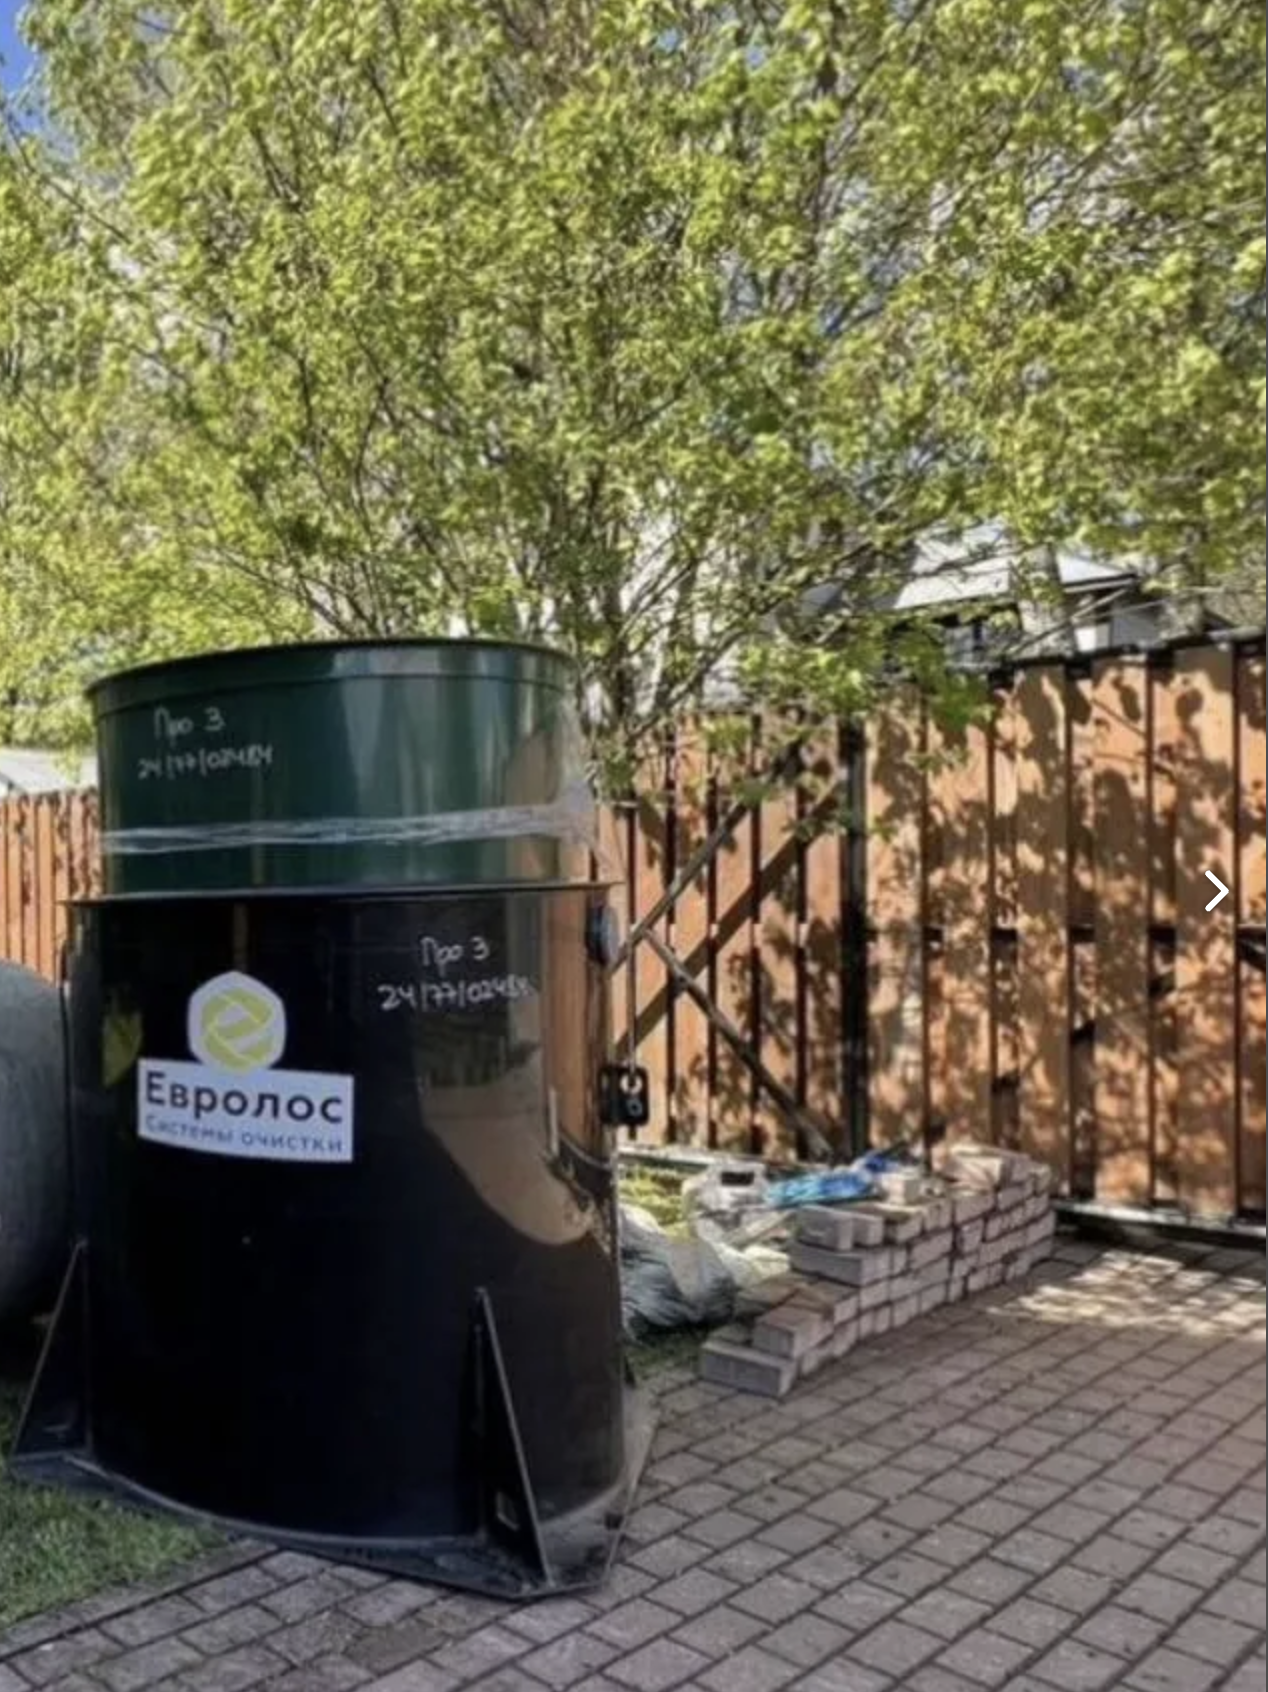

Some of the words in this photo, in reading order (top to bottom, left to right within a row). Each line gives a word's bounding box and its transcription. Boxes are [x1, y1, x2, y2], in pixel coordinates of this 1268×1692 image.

[203, 706, 226, 731] 3
[421, 936, 463, 977] Про
[470, 936, 490, 961] 3
[146, 1071, 343, 1123] Евролос
[146, 1115, 232, 1143] Системы
[241, 1131, 342, 1152] очистки
